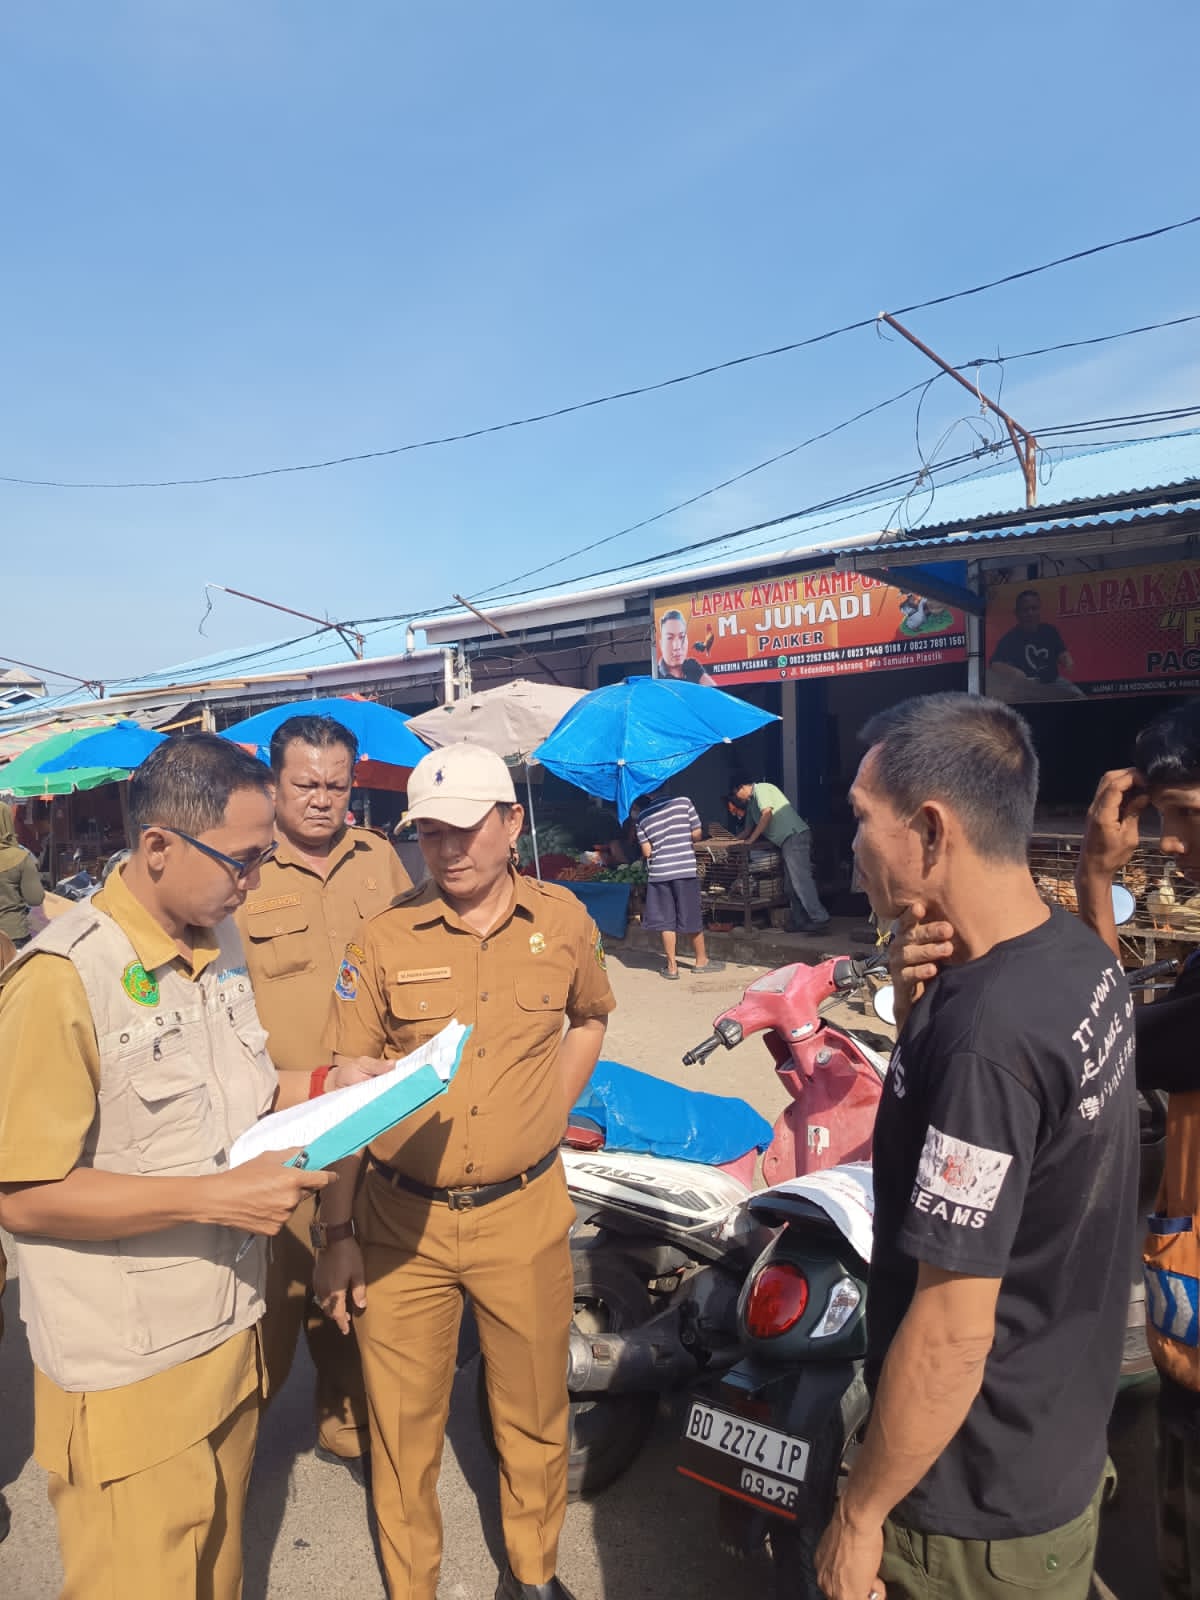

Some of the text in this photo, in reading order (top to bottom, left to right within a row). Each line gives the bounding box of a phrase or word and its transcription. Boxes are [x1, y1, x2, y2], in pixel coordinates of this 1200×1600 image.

[691, 588, 745, 617] LAPAK
[751, 579, 797, 608] AYAM
[1057, 573, 1167, 617] LAPAK
[718, 593, 871, 638] M. JUMADI
[713, 662, 740, 673] MENERIMA
[909, 640, 928, 651] 0823
[758, 631, 824, 651] PAIKER
[1072, 1018, 1094, 1052] IT
[719, 1421, 767, 1463] 2274
[777, 1440, 801, 1473] IP
